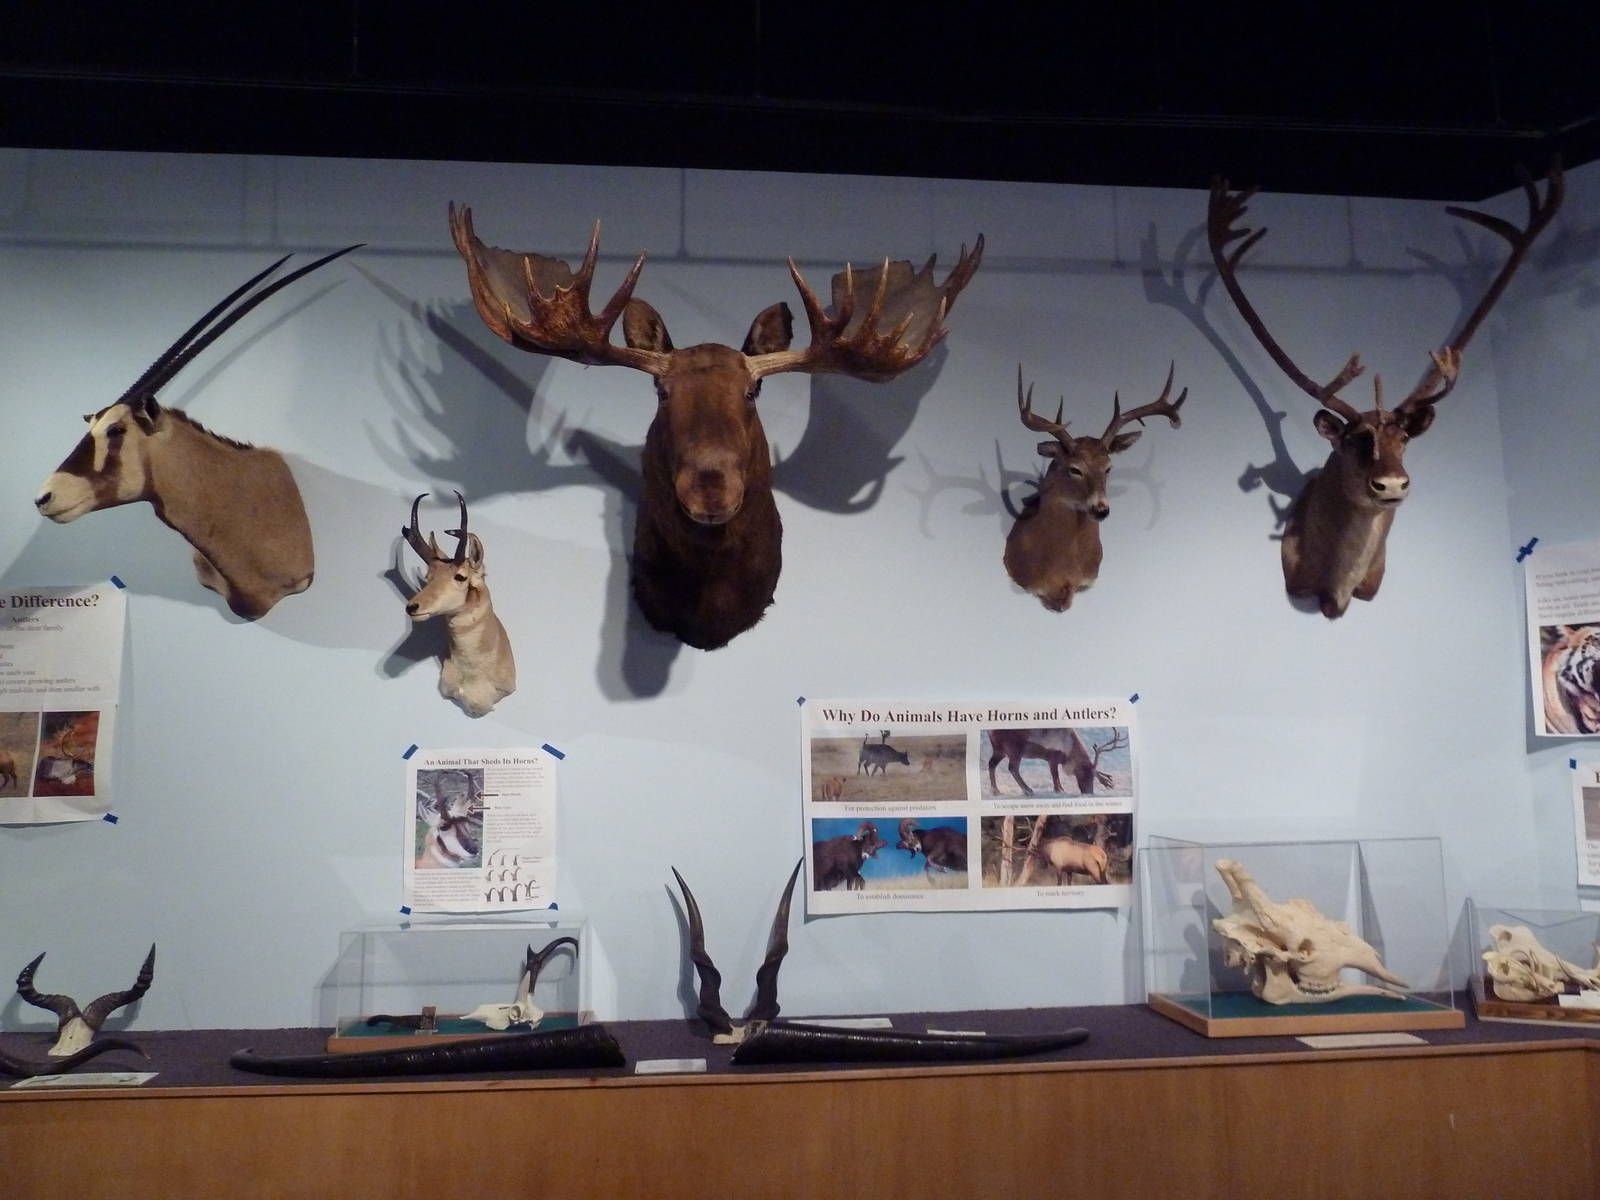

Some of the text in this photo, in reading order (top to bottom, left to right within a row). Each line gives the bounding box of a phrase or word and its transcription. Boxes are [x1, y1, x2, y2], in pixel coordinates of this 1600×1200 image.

[11, 593, 100, 609] Difference?
[822, 706, 1117, 725] Why Do Animals Have Horns and Antlers?
[424, 759, 435, 767] An
[437, 758, 460, 767] Animal
[463, 758, 479, 766] That
[481, 758, 501, 766] Sheds
[503, 757, 512, 766] Its
